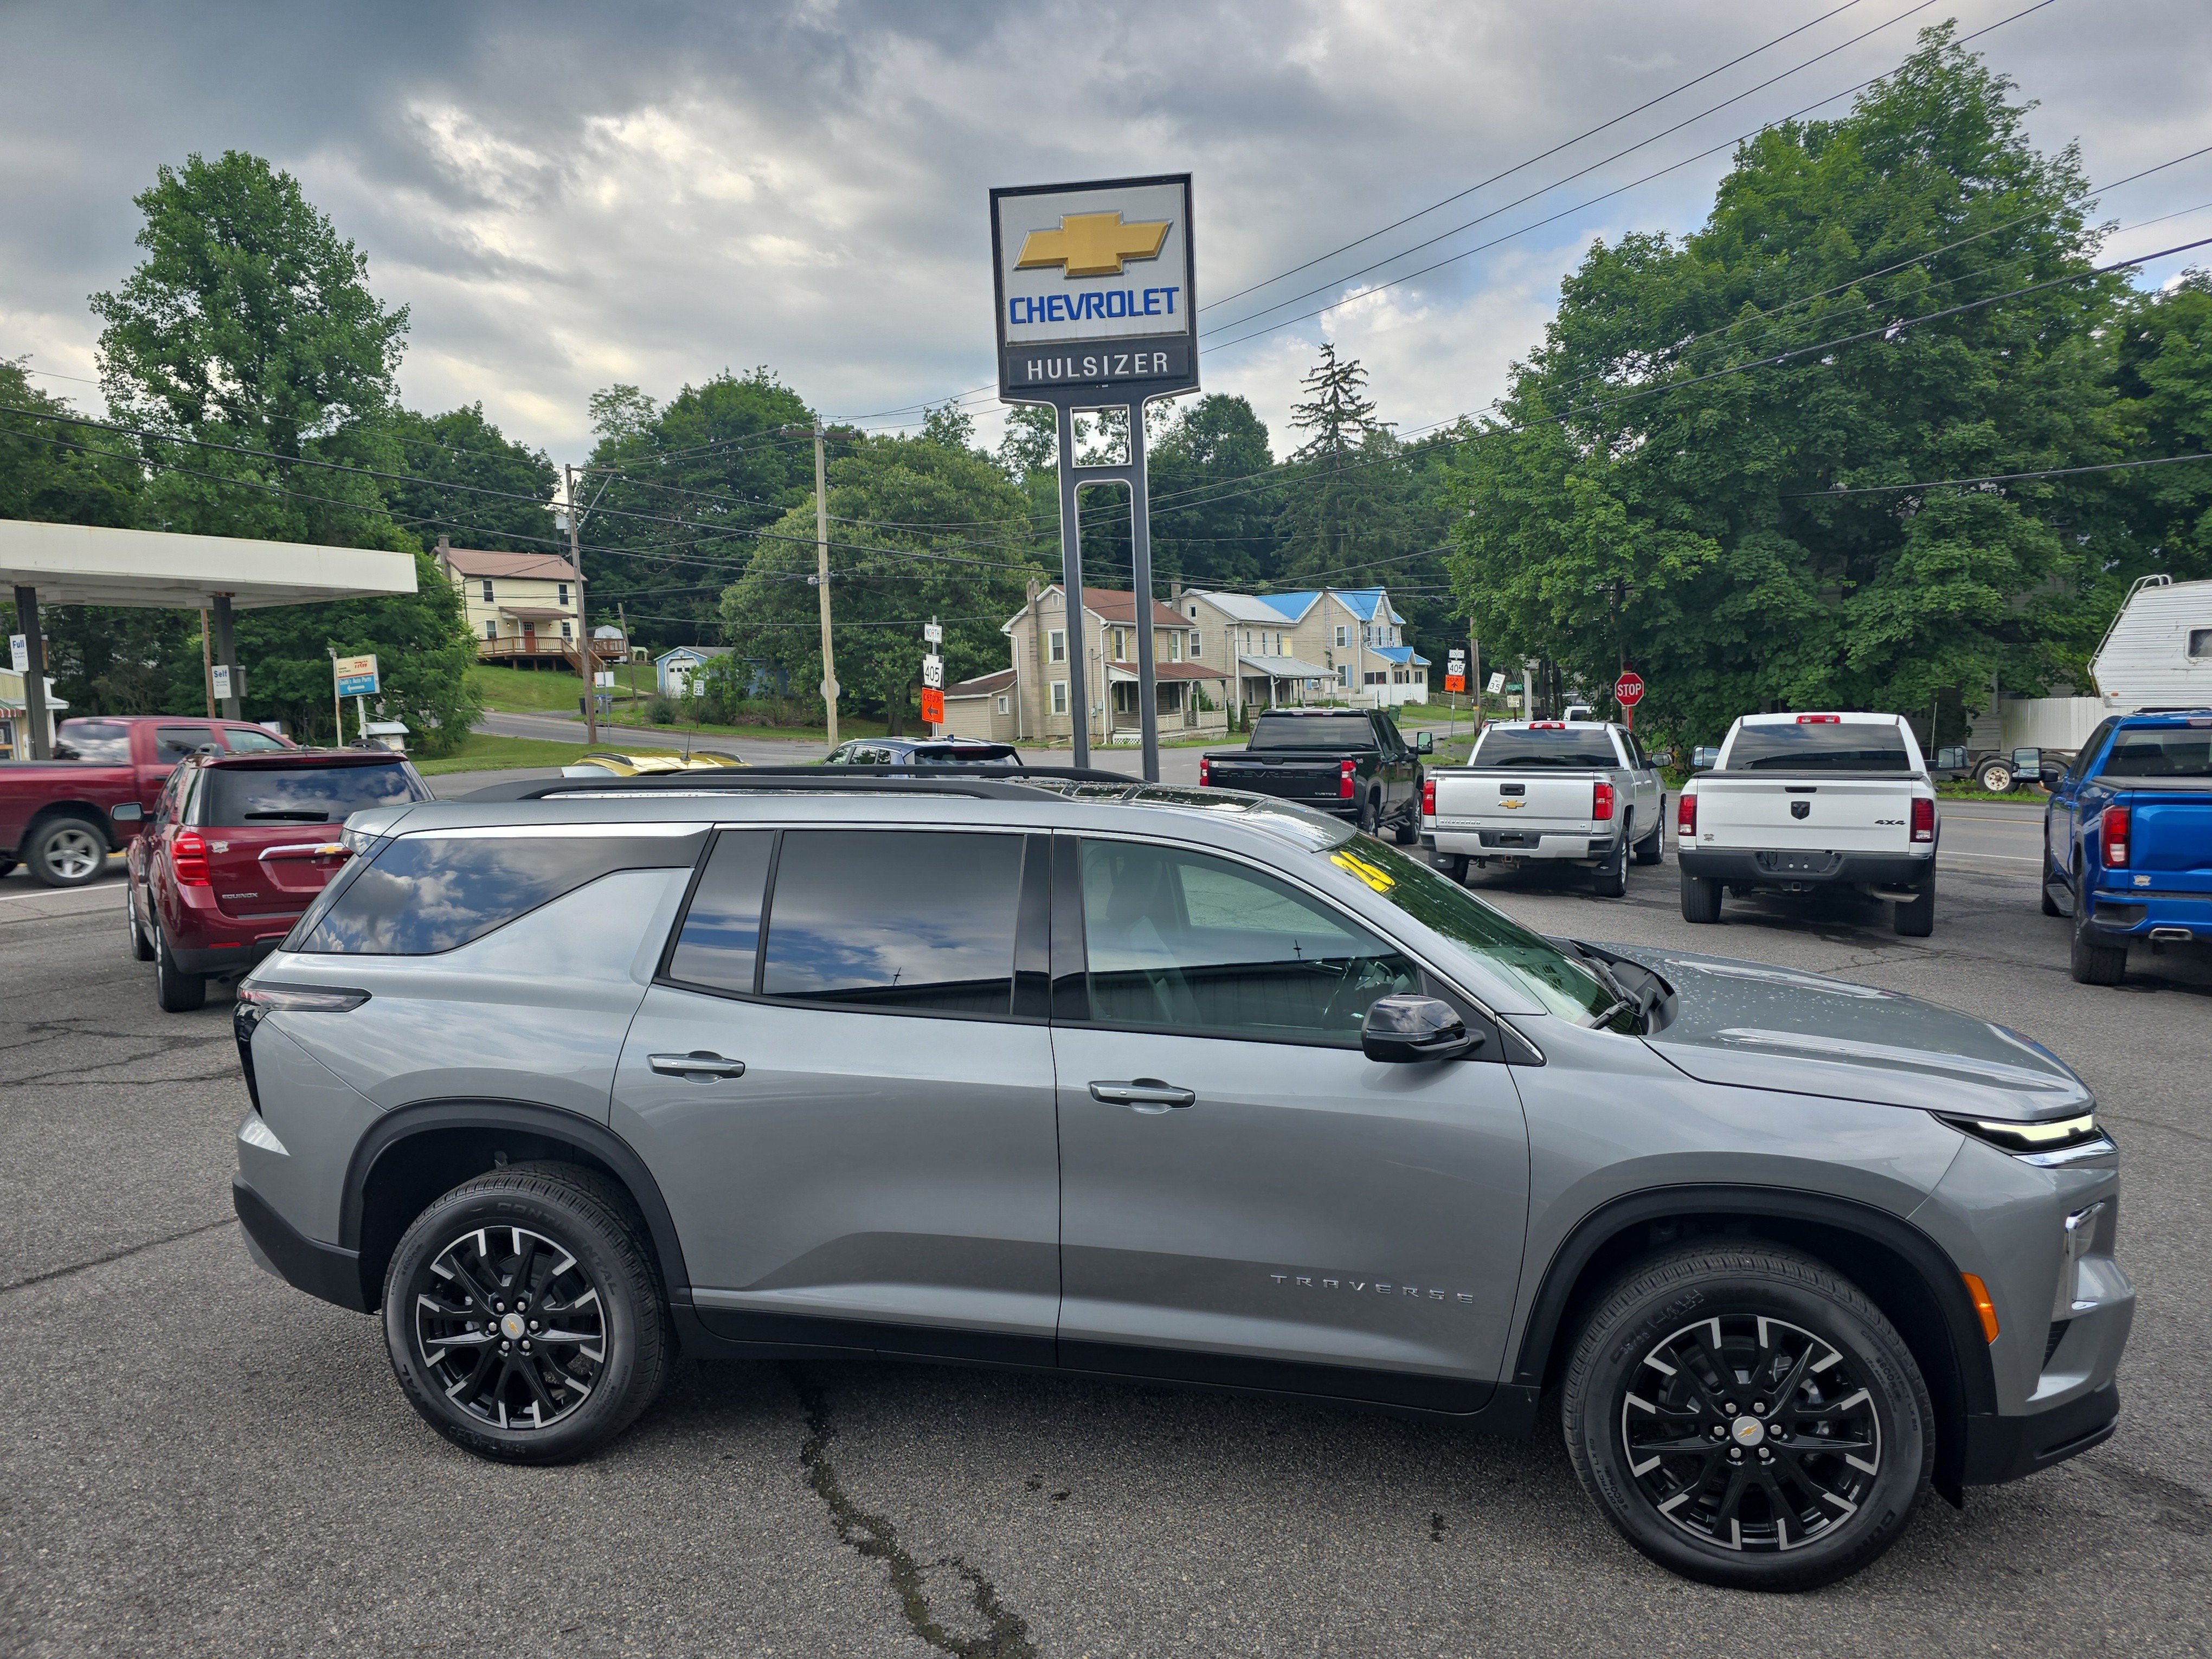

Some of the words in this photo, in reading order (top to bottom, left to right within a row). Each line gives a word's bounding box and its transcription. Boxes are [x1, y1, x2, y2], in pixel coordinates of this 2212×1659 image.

[1009, 287, 1179, 324] CHEVROLET
[1027, 351, 1168, 381] HULSIZER
[926, 628, 940, 636] NORTH
[12, 640, 24, 648] Full
[925, 666, 940, 682] 405
[1450, 664, 1463, 673] 405
[1489, 683, 1500, 691] 35
[1617, 683, 1642, 697] STOP
[924, 693, 942, 704] DETOUR
[1217, 770, 1332, 779] CHEVROLET
[1270, 1274, 1474, 1304] TRAVERSE
